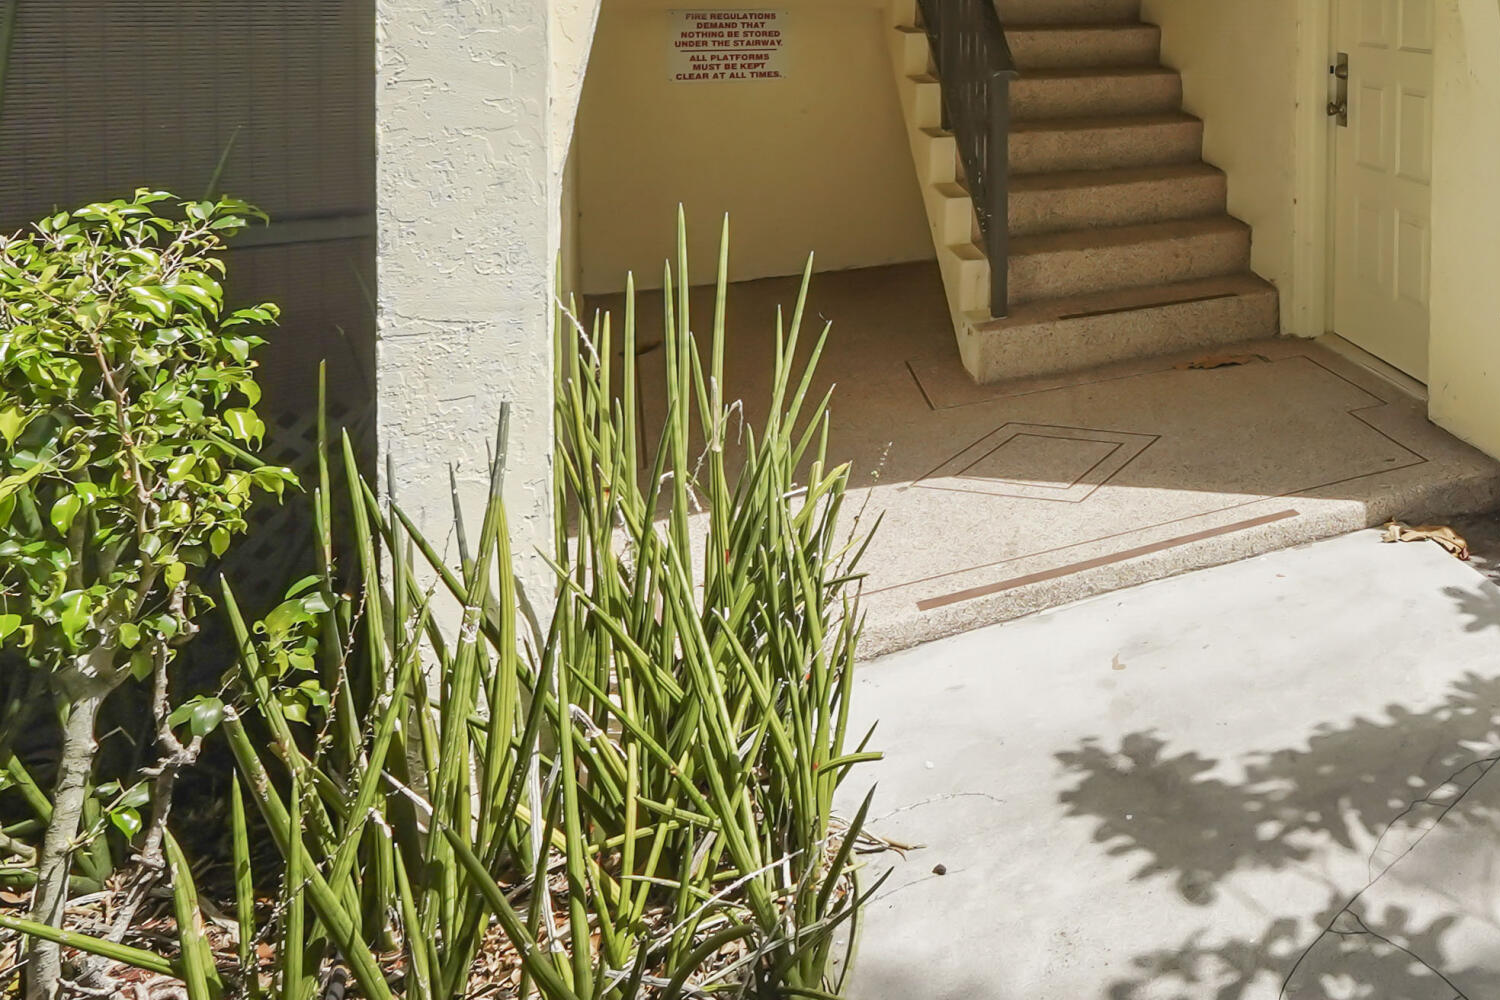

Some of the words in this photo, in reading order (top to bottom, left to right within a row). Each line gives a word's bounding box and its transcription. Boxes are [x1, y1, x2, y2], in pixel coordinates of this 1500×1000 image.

[710, 12, 777, 20] REGULATIONS
[741, 21, 766, 29] THAT
[742, 30, 781, 38] STORED
[674, 40, 708, 48] UNDER
[733, 39, 783, 47] STAIRWAY.
[689, 54, 708, 62] ALL
[710, 53, 770, 61] PLATFORMS
[692, 63, 721, 71] MUST
[729, 71, 747, 79] ALL
